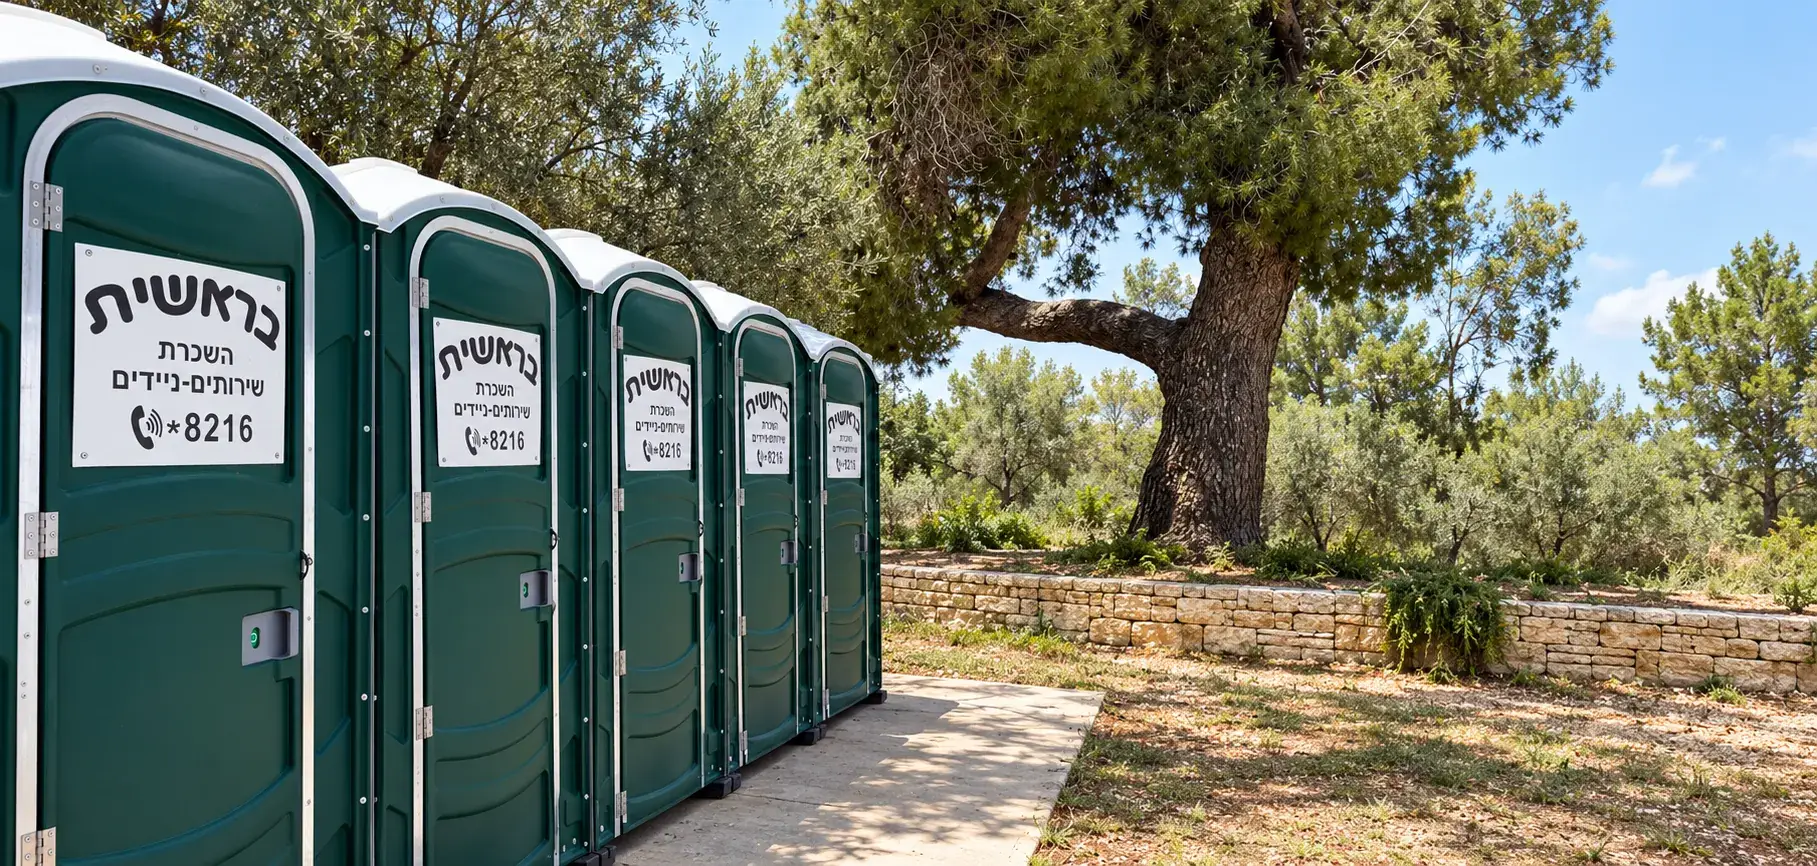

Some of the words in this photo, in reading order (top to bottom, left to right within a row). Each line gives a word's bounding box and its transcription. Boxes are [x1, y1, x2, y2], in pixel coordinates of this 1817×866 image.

[84, 274, 280, 351] בראשית
[158, 341, 234, 365] השכרת
[438, 335, 538, 386] בראשית
[112, 369, 264, 397] שירותים-ניידים
[476, 382, 514, 397] השכרת
[625, 367, 690, 407] בראשית
[454, 402, 531, 419] שירותים-ניידים
[650, 405, 675, 416] השכרת
[745, 391, 788, 422] בראשית
